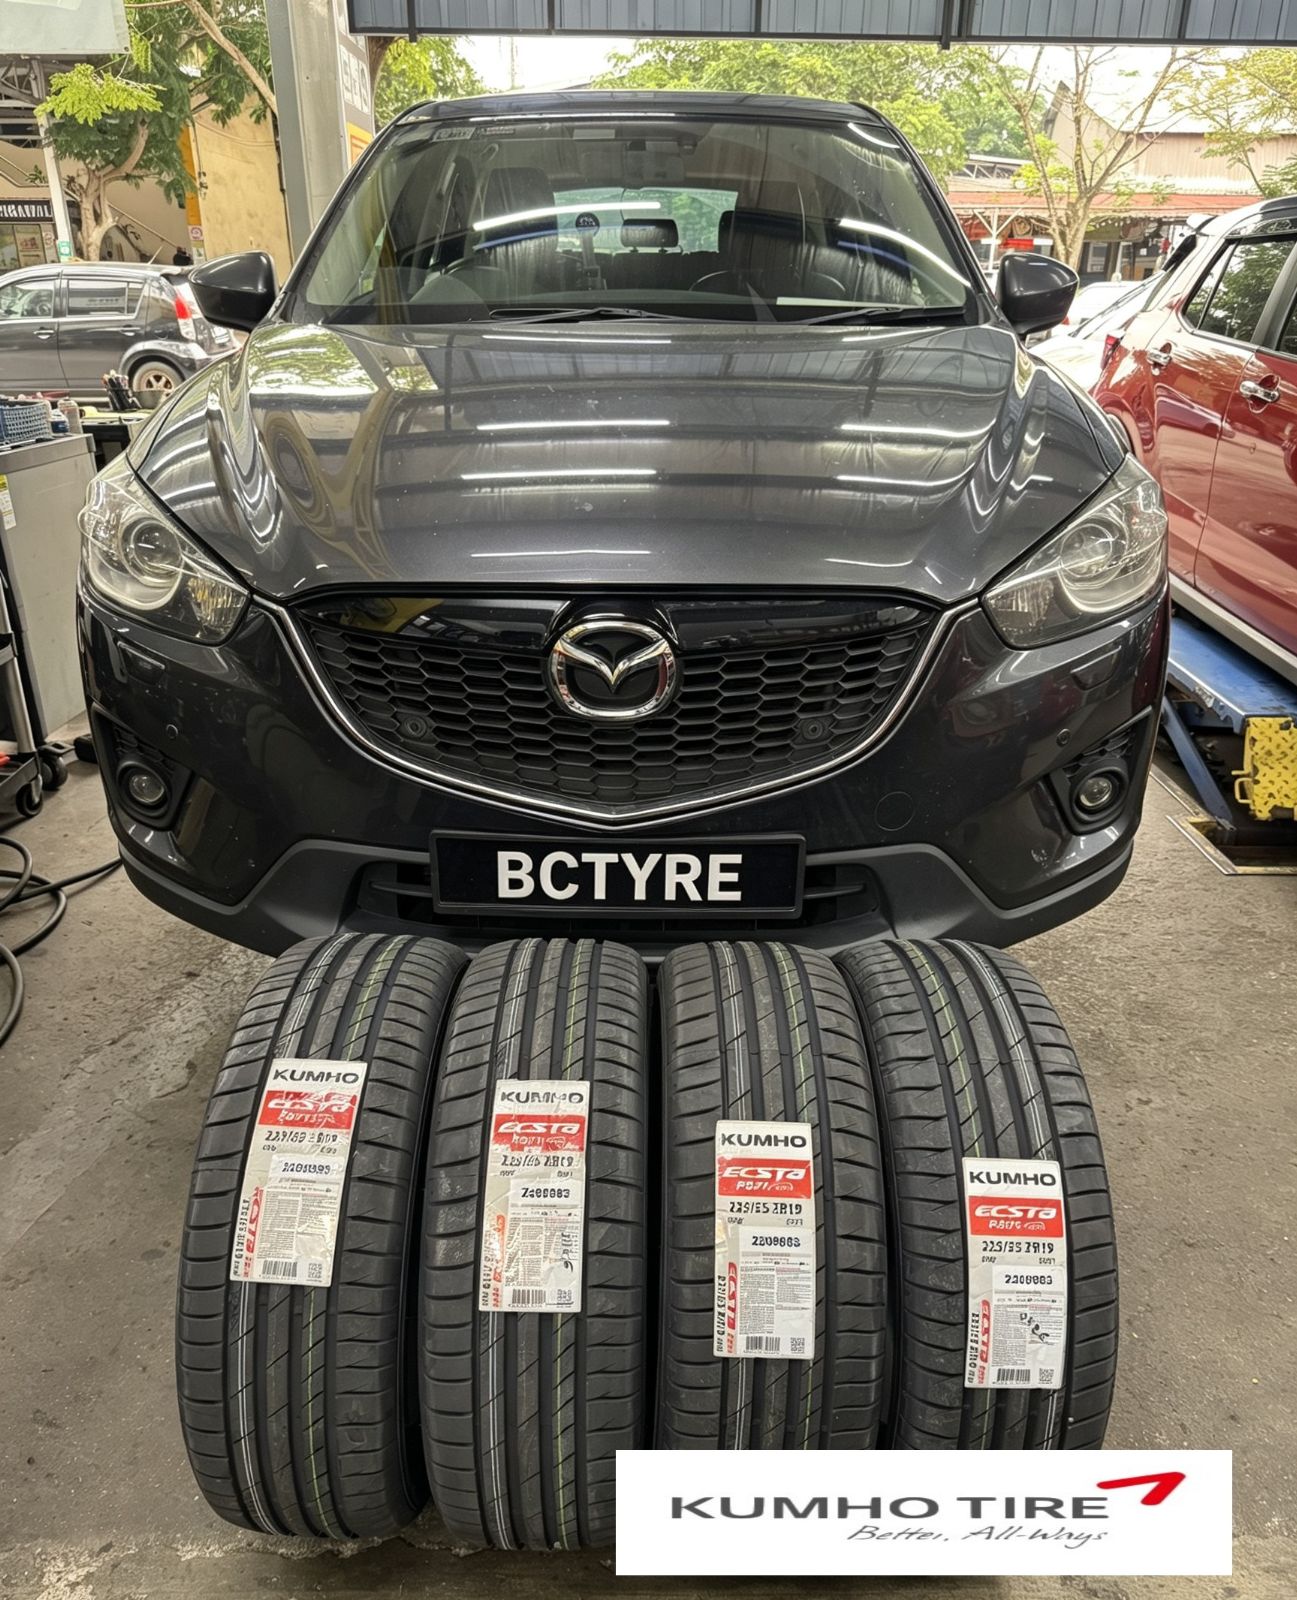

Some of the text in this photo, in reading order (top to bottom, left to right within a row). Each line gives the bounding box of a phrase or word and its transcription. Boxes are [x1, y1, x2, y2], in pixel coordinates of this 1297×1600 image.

[497, 850, 743, 902] BCTYRE
[273, 1068, 359, 1084] KUMHO
[721, 1133, 807, 1148] KUMHO
[969, 1171, 1057, 1186] KUMHO
